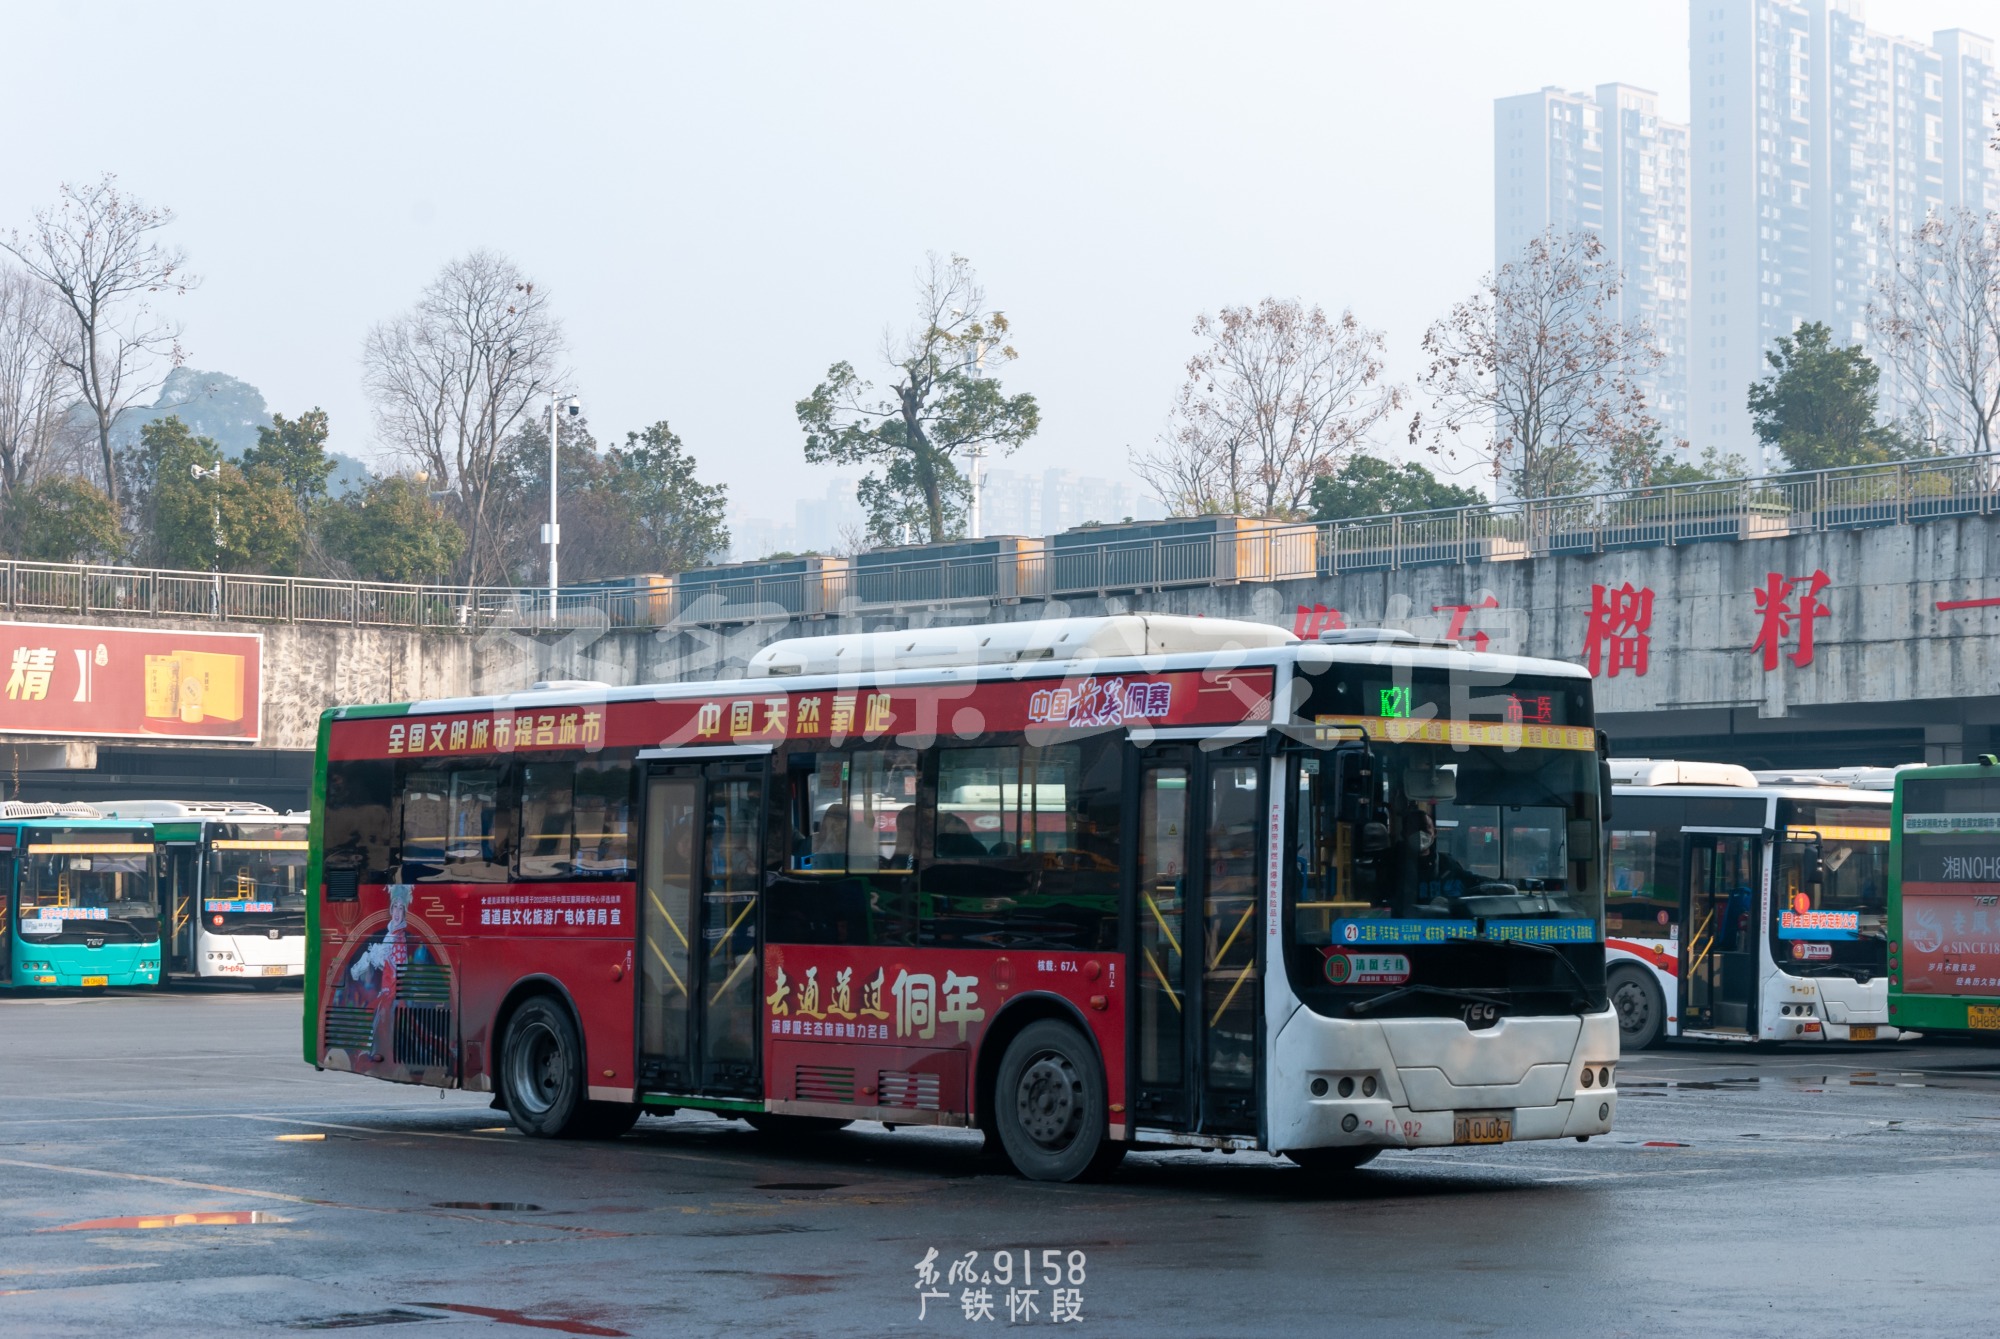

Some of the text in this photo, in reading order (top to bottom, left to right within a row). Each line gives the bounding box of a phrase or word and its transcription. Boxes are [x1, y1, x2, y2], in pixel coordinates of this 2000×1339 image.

[1028, 676, 1173, 728] 中国最美侗寨
[1380, 686, 1411, 718] K21
[697, 693, 892, 738] 中国天然氧吧
[387, 711, 602, 755] 全国文明城市提名城市
[1973, 896, 1998, 907] TEG
[481, 908, 621, 926] 通道县文化旅游广电体育局 宣
[1952, 910, 2000, 936] 老鳳
[1355, 958, 1404, 971] 清风专线
[1928, 963, 1977, 972] 岁月不败风华
[766, 966, 986, 1042] 去通道过侗年
[1461, 1003, 1496, 1020] TEG
[771, 1019, 889, 1039] 深呼吸生态旅游魅力名县
